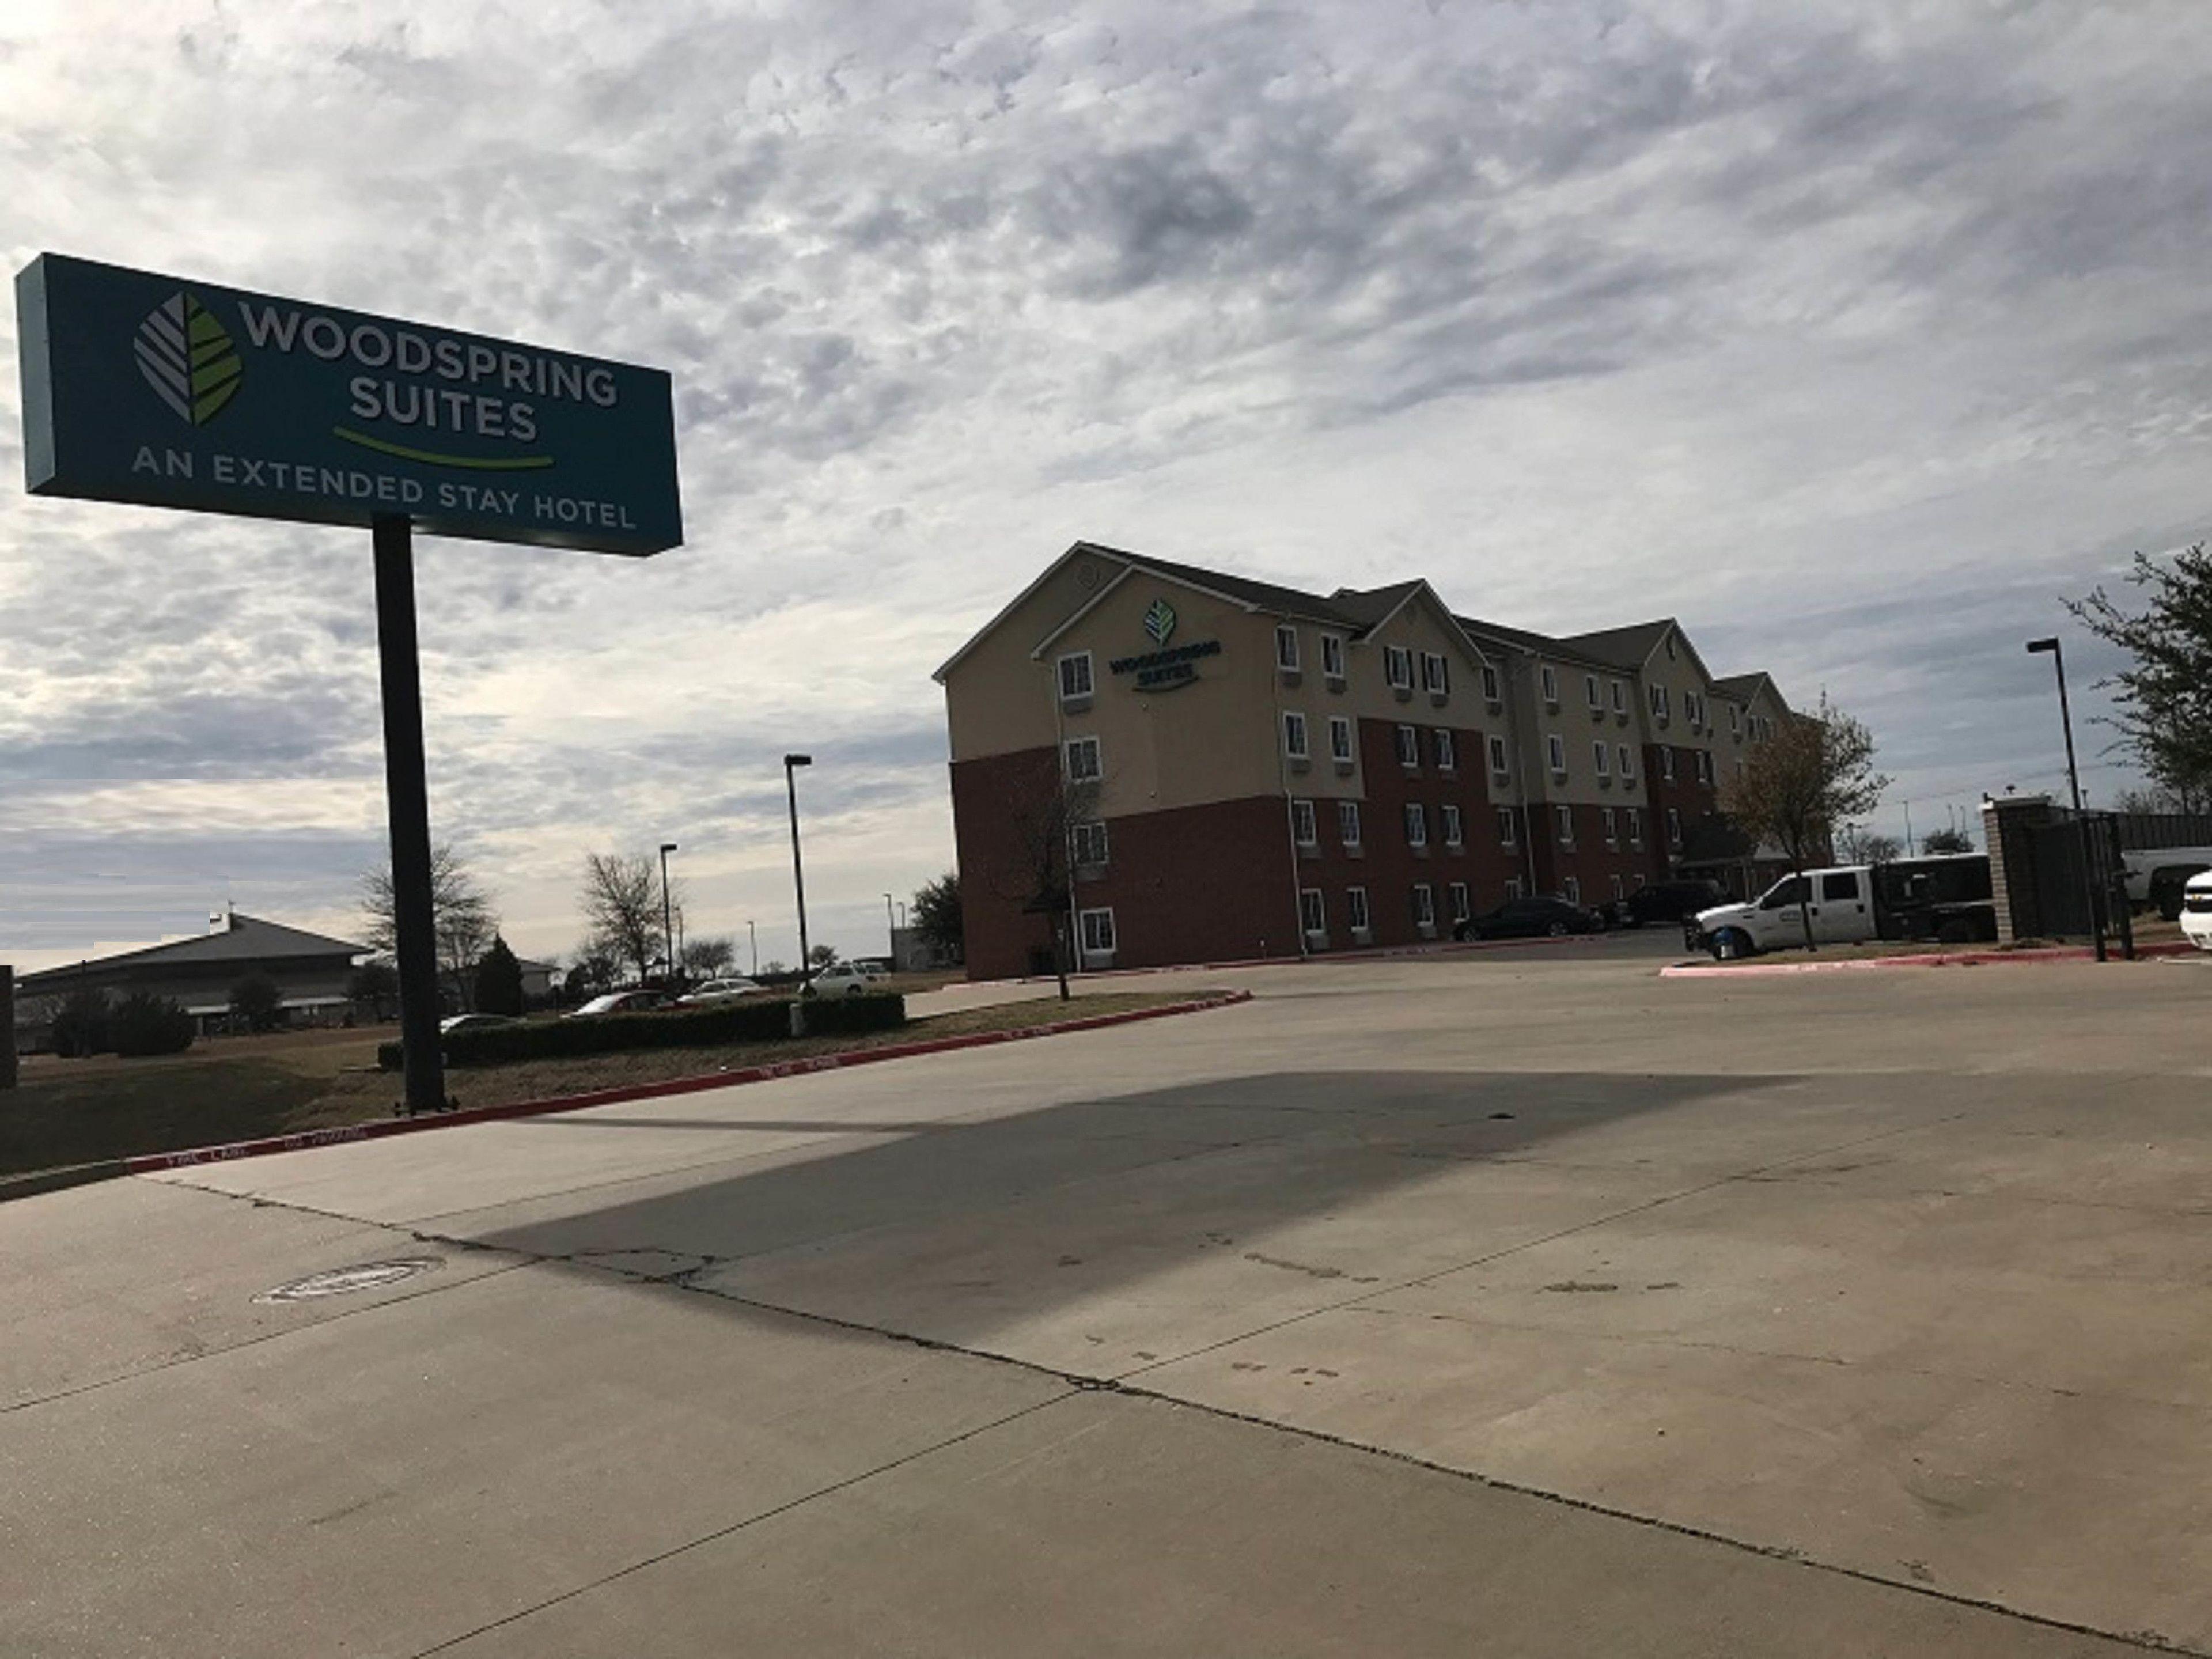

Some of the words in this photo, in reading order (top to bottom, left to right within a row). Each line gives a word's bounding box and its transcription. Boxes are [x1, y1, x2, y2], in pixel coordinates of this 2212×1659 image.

[238, 301, 618, 407] WOODSPRING
[350, 377, 536, 442] SUITES
[132, 446, 193, 478] AN
[214, 454, 423, 502] EXTENDED
[438, 482, 519, 515] STAY
[534, 494, 636, 529] HOTEL
